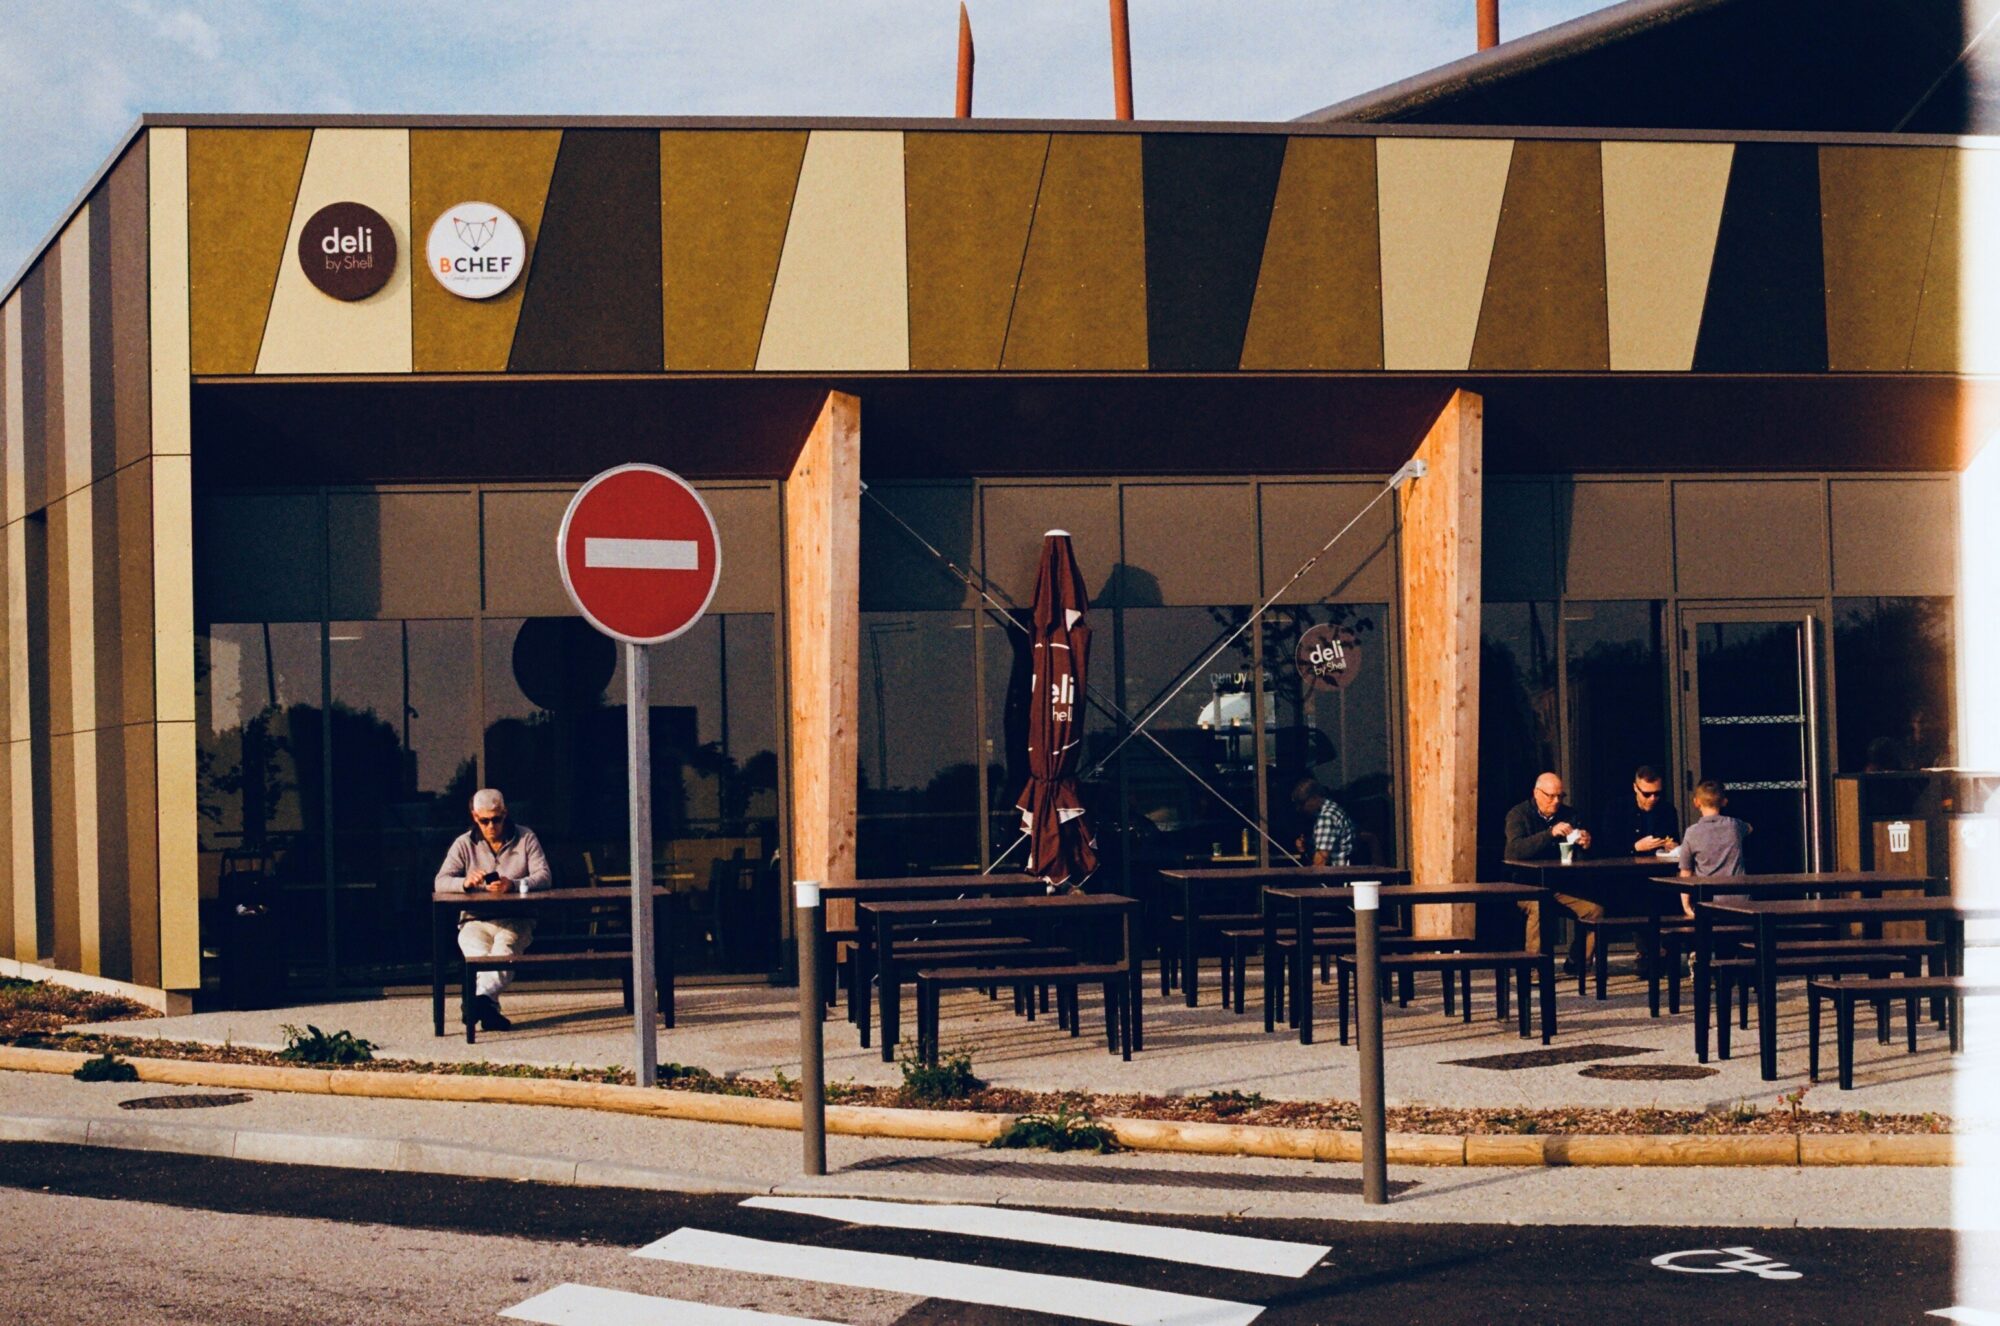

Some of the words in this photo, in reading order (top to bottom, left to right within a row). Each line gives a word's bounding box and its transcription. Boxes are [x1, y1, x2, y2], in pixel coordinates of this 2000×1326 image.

[321, 226, 372, 254] deli
[325, 255, 341, 273] by
[343, 254, 373, 270] Shell
[439, 256, 512, 273] BCHEF
[1310, 639, 1344, 664] deli
[1313, 665, 1326, 676] by
[1326, 658, 1347, 672] Shell
[1052, 705, 1073, 722] hell
